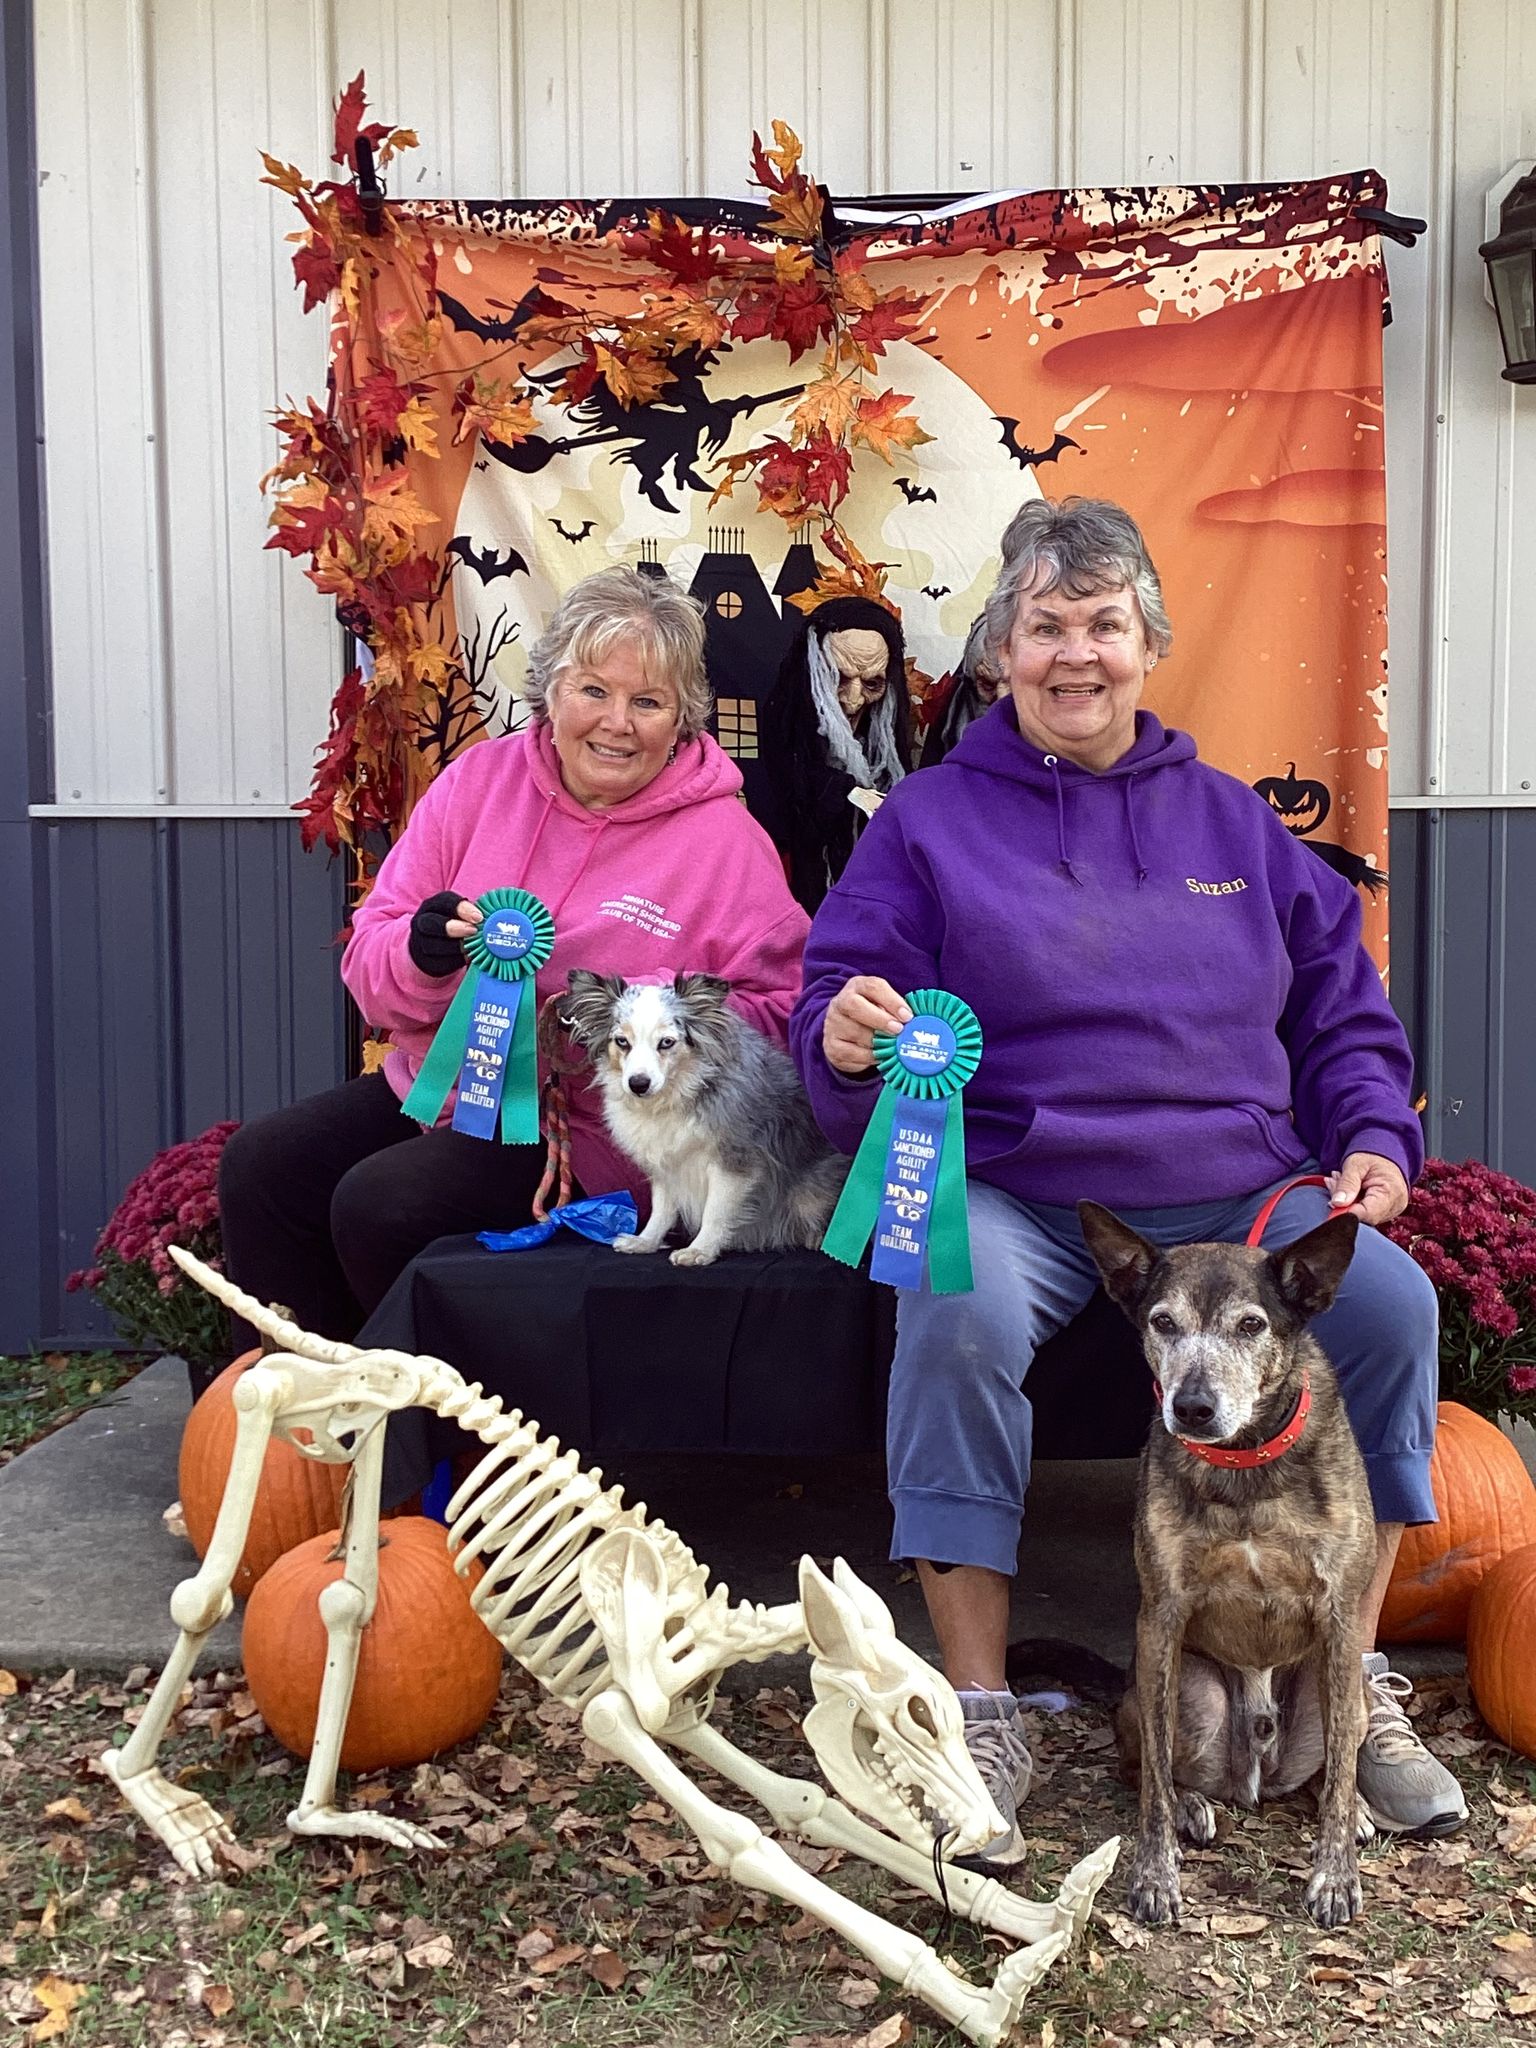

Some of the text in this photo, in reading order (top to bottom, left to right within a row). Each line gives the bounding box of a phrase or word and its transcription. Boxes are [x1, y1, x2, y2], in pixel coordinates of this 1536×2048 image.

[1185, 877, 1248, 896] Suzan
[621, 894, 666, 916] MINIATURE
[600, 901, 682, 932] AMERICAN SHEPHERD
[622, 913, 636, 923] OF
[636, 918, 653, 933] THE
[487, 937, 527, 949] USDAA
[480, 1002, 508, 1017] USDAA
[474, 1012, 509, 1028] SANCTIONED
[477, 1025, 503, 1038] AGILITY
[479, 1036, 496, 1048] TRIAL
[899, 1048, 946, 1064] USDAA
[472, 1083, 489, 1095] TEAM
[461, 1092, 494, 1108] QUALIFIER
[899, 1128, 933, 1146] USDAA
[892, 1140, 936, 1159] SANCTIONED
[896, 1154, 928, 1171] AGILITY
[898, 1167, 920, 1183] TRIAL
[891, 1223, 913, 1240] TEAM
[880, 1234, 920, 1255] QUALIFIER
